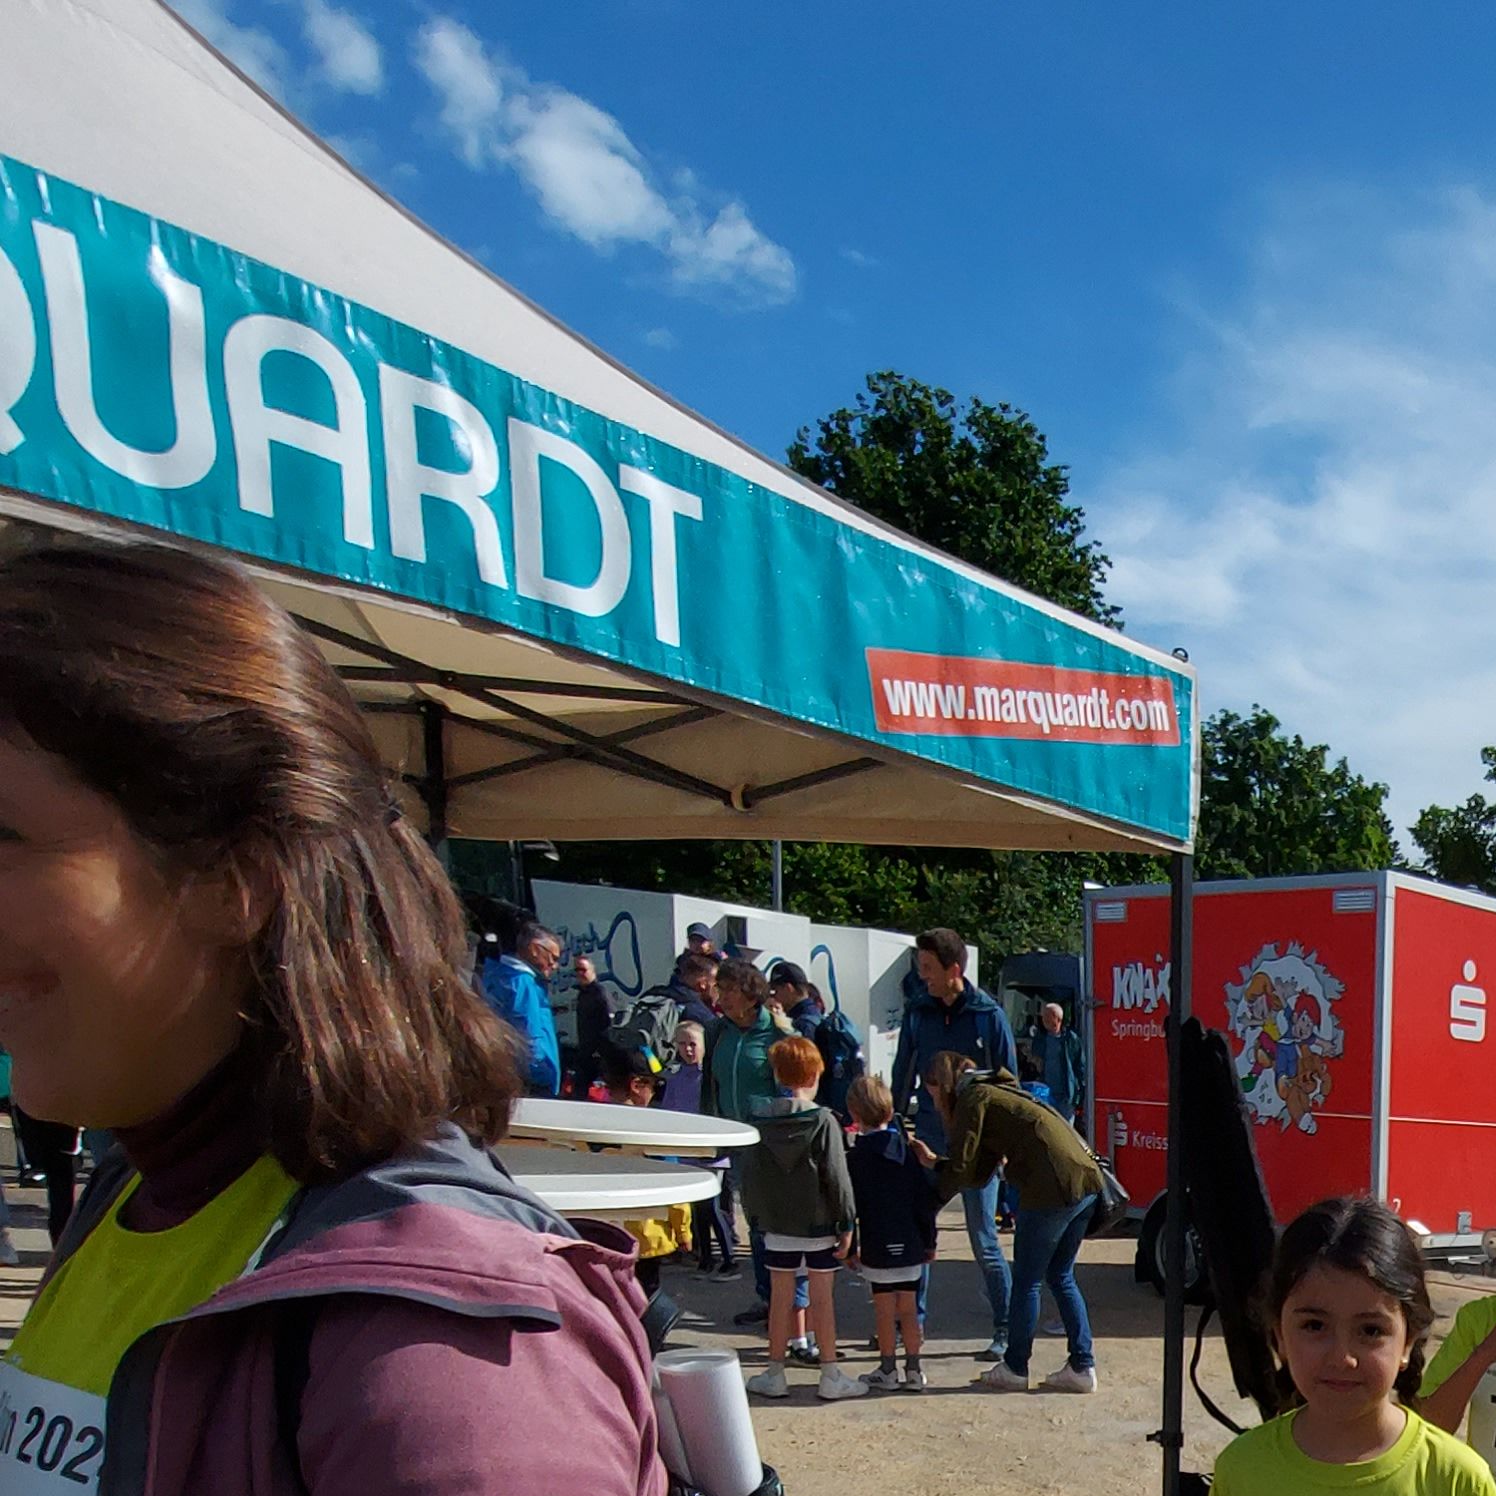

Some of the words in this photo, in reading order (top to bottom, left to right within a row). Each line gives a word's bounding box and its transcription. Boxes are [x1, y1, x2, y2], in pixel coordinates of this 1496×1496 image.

[0, 219, 702, 648] UARDT
[883, 679, 1170, 734] www.marquardt.com
[16, 1406, 105, 1484] 202
